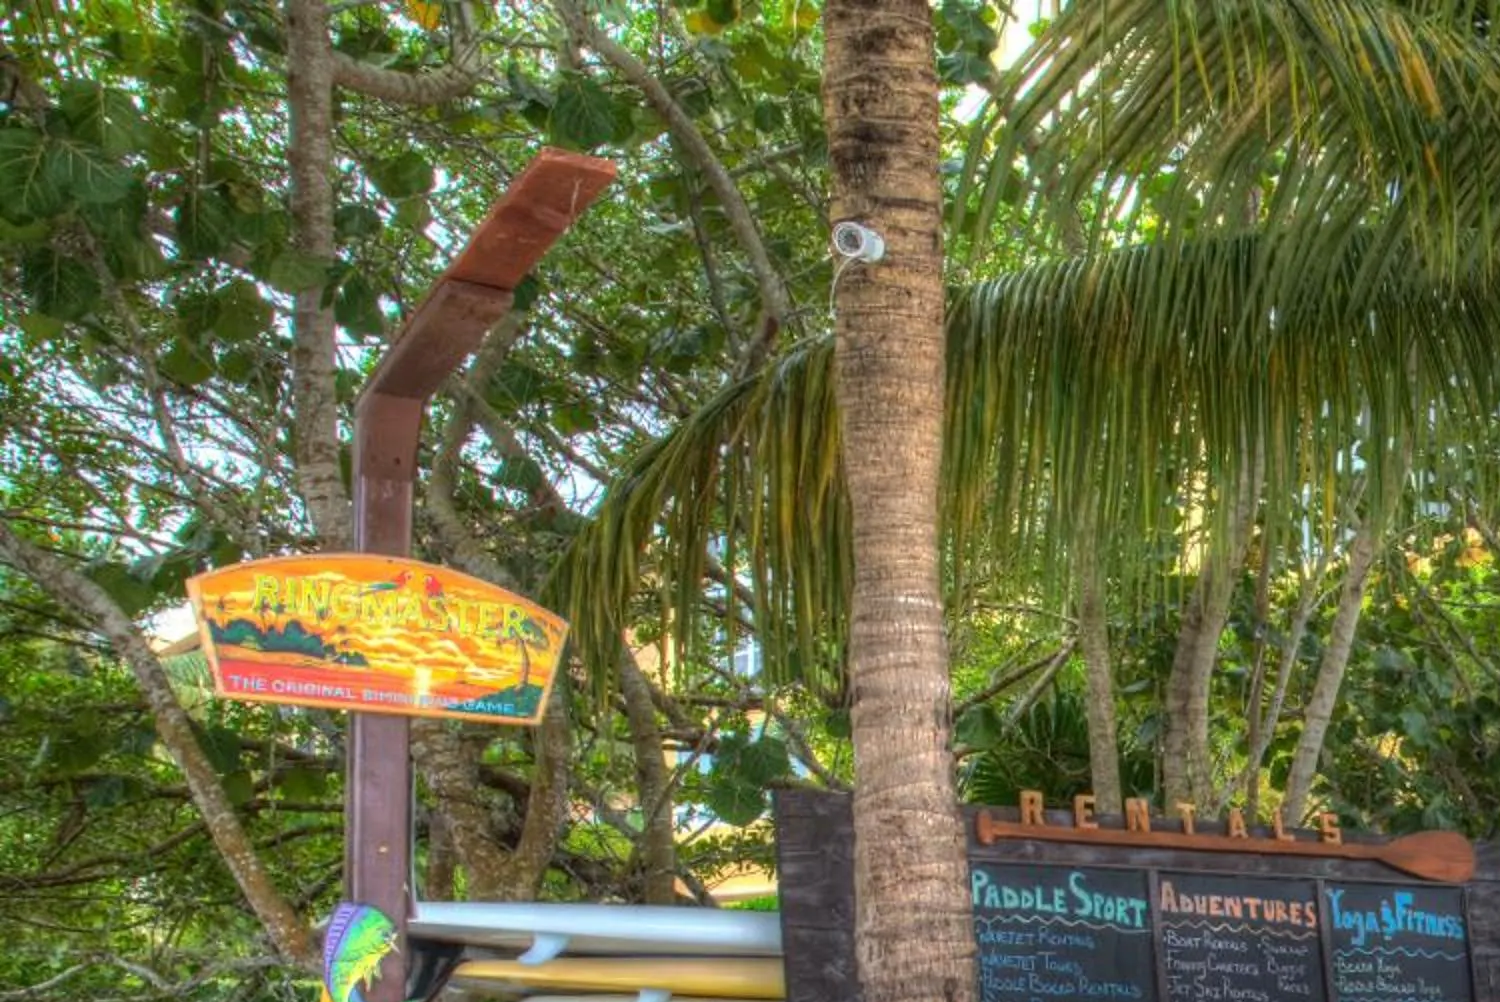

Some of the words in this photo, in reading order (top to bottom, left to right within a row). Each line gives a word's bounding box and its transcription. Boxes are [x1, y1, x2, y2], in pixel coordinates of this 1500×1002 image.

[251, 573, 529, 638] RINGMASTER
[228, 674, 267, 691] THE
[272, 679, 357, 699] ORIGINAL
[462, 700, 516, 714] GAME
[1019, 789, 1343, 846] RENTALS
[972, 870, 1068, 914] PADDLE
[1069, 871, 1148, 928] SPORT
[1160, 880, 1317, 928] ADVENTURES
